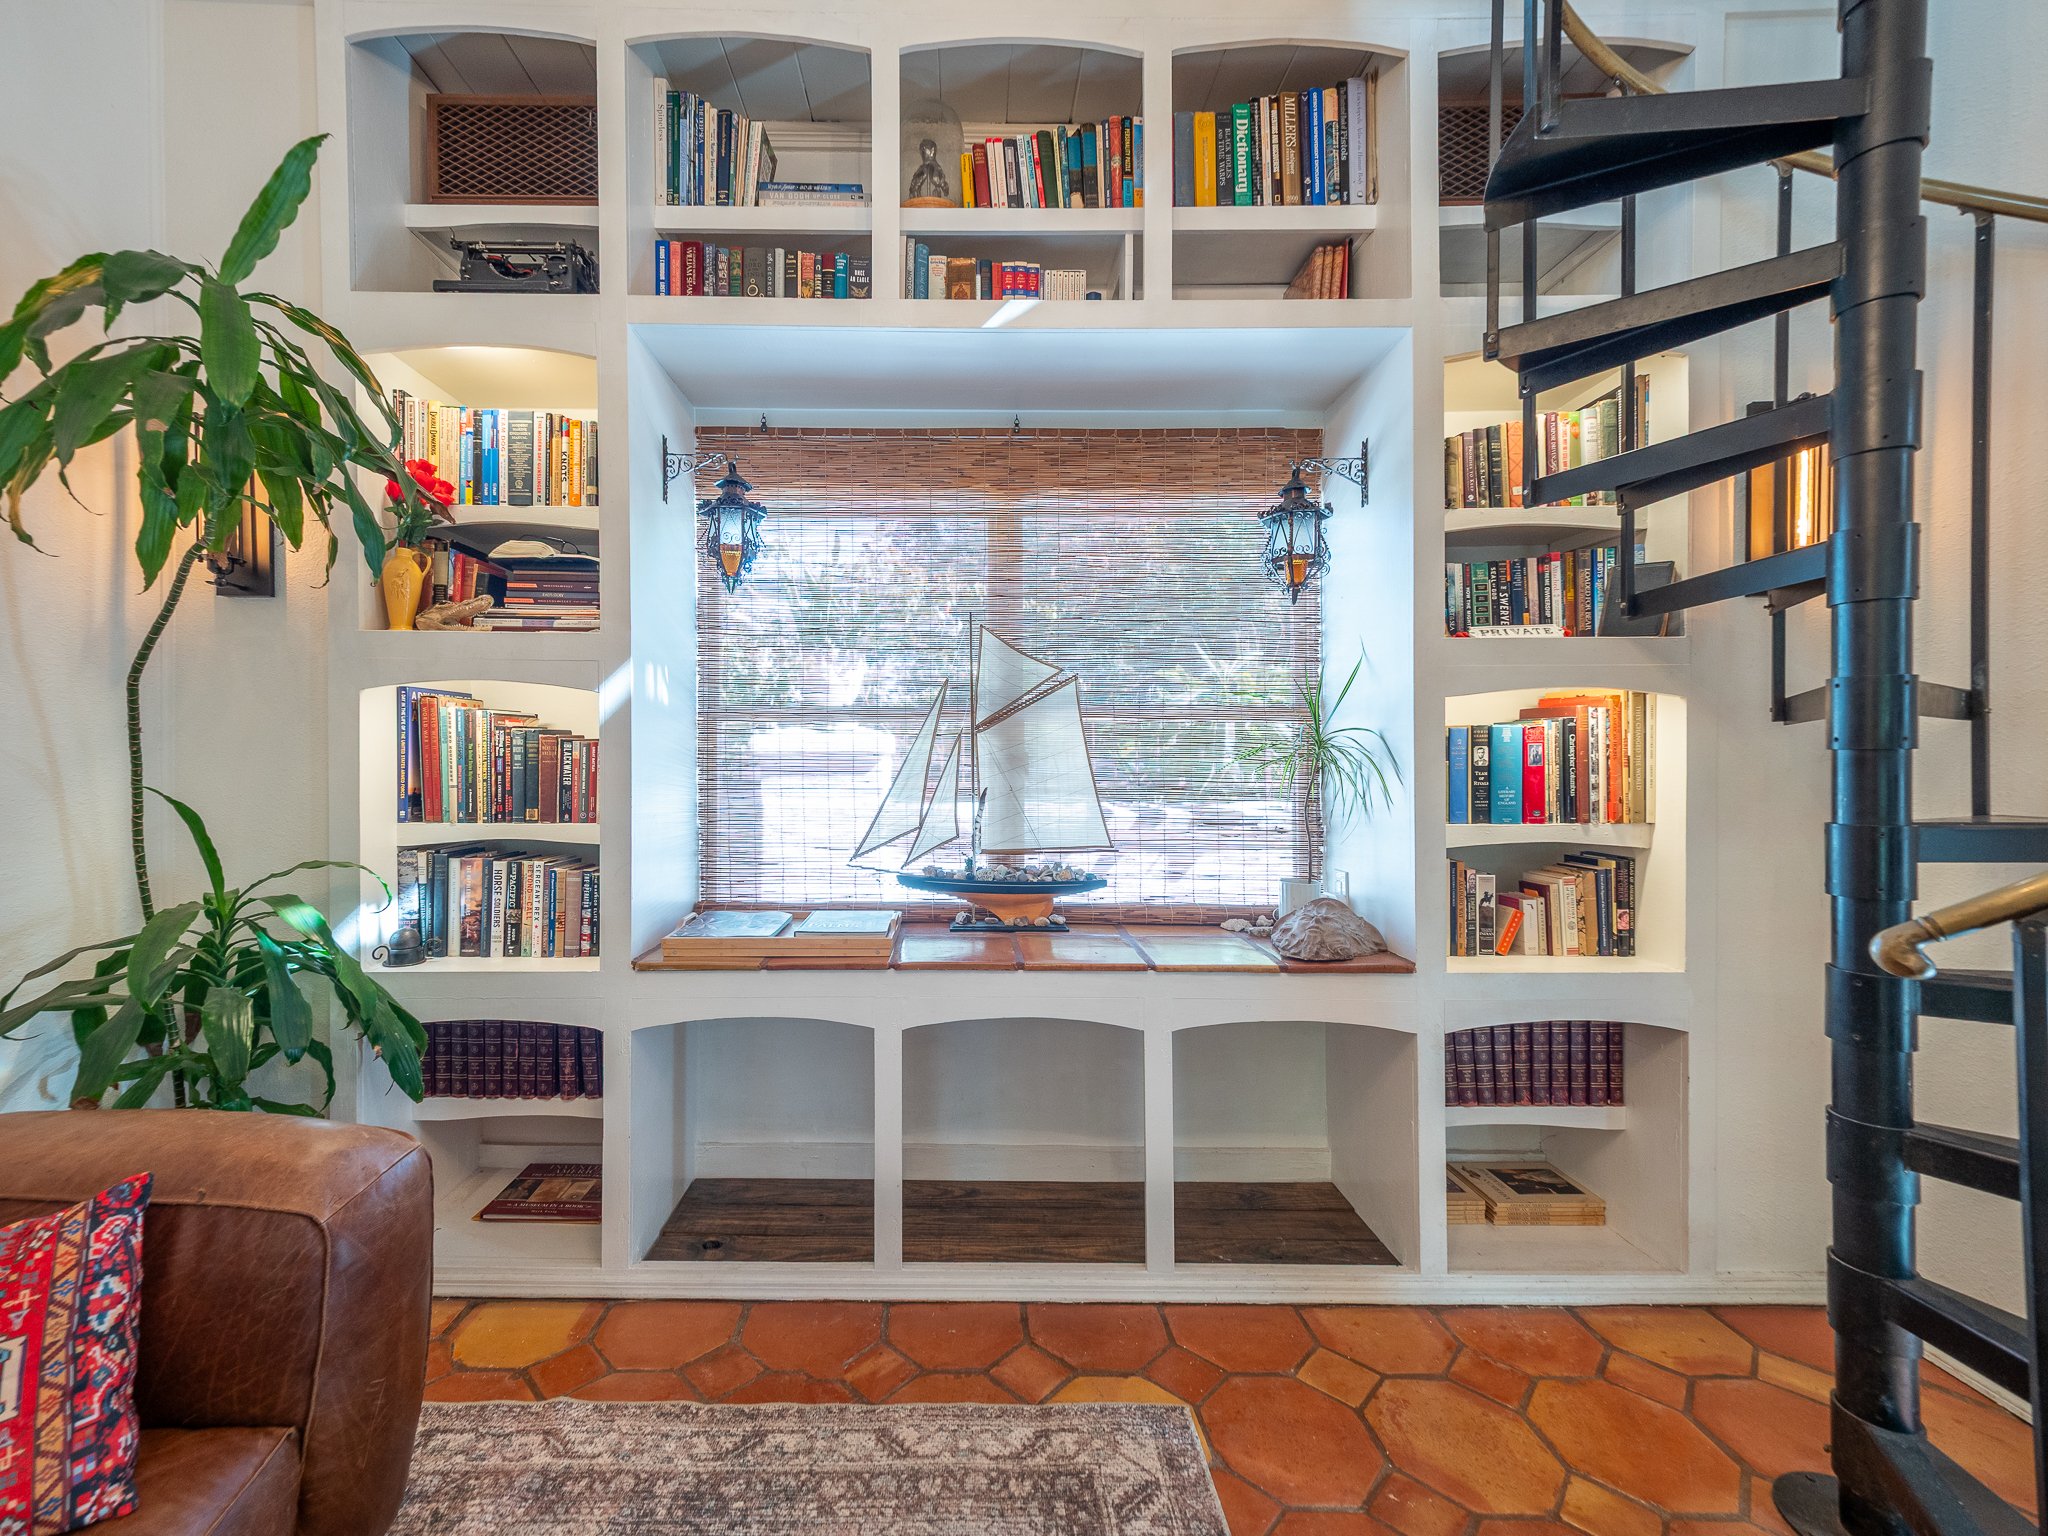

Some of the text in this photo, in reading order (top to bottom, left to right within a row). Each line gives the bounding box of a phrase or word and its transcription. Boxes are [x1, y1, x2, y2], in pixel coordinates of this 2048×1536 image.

[656, 104, 665, 142] Spineless
[1284, 96, 1297, 147] MILLER'S
[1235, 118, 1249, 193] Dictionary
[1634, 550, 1644, 565] SHA
[1499, 592, 1510, 626] SWERVE
[1480, 627, 1554, 636] PRIVATE
[562, 743, 572, 786] BLACKWATER
[493, 869, 502, 928] HORSE SOLDIERS
[509, 874, 517, 908] PACIFIC
[583, 884, 591, 908] OPERATOR
